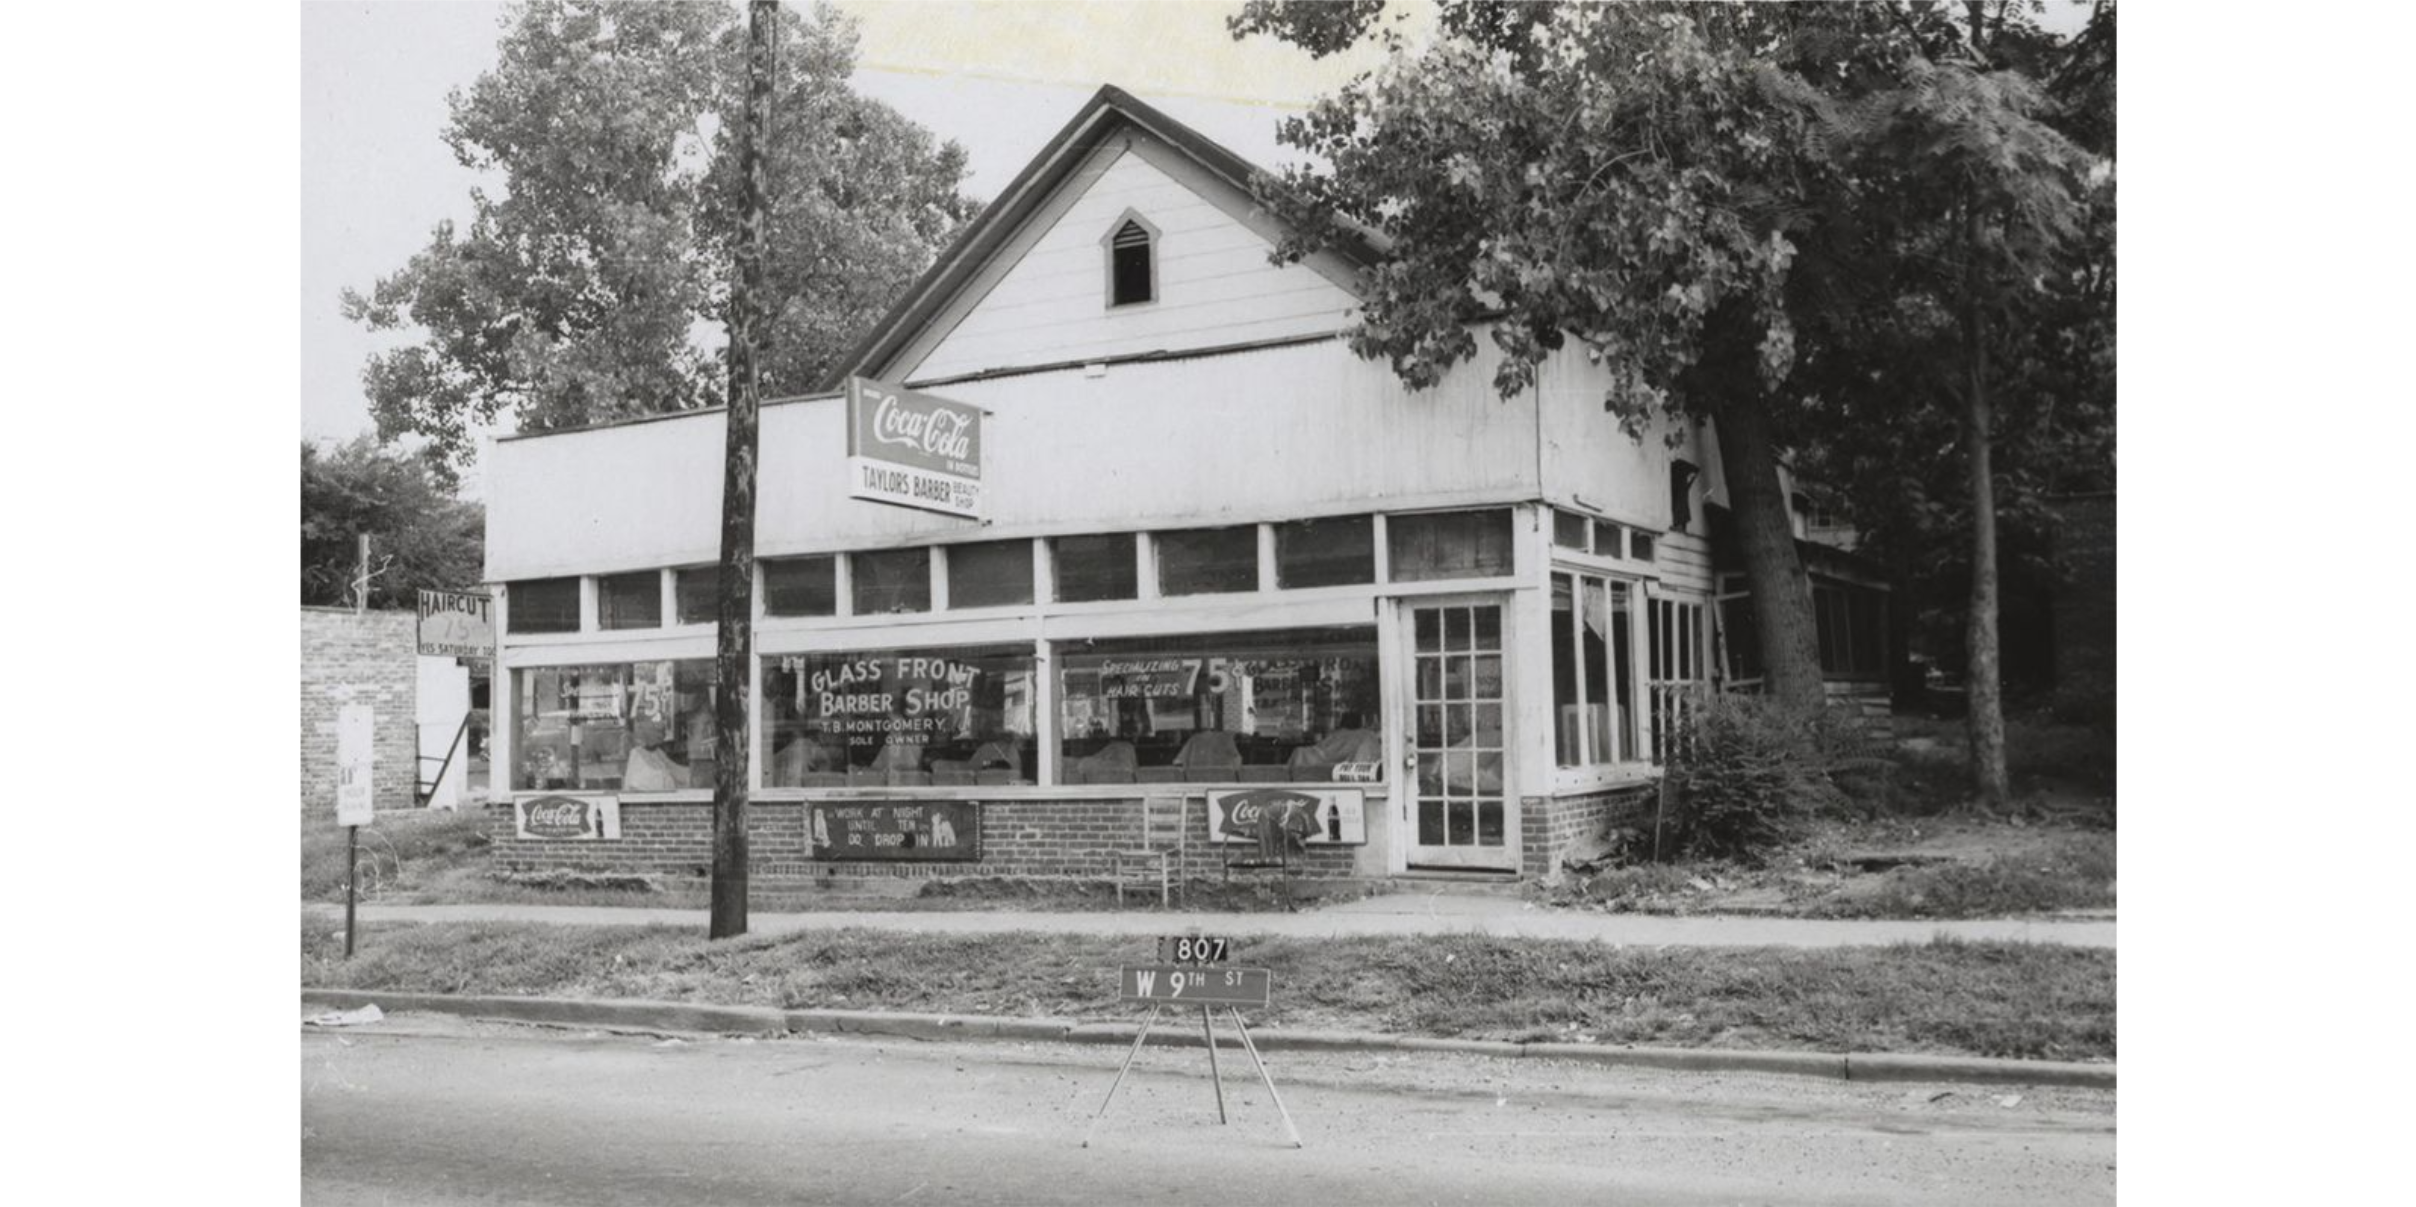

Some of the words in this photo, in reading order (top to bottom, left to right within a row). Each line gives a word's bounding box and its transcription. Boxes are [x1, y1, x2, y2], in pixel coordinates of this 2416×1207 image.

[873, 395, 973, 460] Coca-Cola
[862, 465, 909, 495] TAYLORS
[913, 475, 951, 504] BARBER
[421, 591, 491, 623] HAIRCUT
[811, 659, 882, 692] GLASS
[897, 658, 981, 688] FRONT
[1101, 659, 1180, 675] SPECIALIZING
[820, 692, 893, 717] BARBER
[905, 688, 970, 715] SHOP
[850, 736, 874, 746] SOLE
[885, 734, 930, 745] OWNER
[870, 807, 884, 818] AT
[893, 806, 924, 819] NIGHT
[897, 819, 916, 831] TEN
[875, 833, 905, 847] DROP
[1177, 938, 1226, 960] 807
[1136, 970, 1156, 998] W
[1169, 971, 1206, 998] 9TH
[1224, 970, 1244, 986] ST
